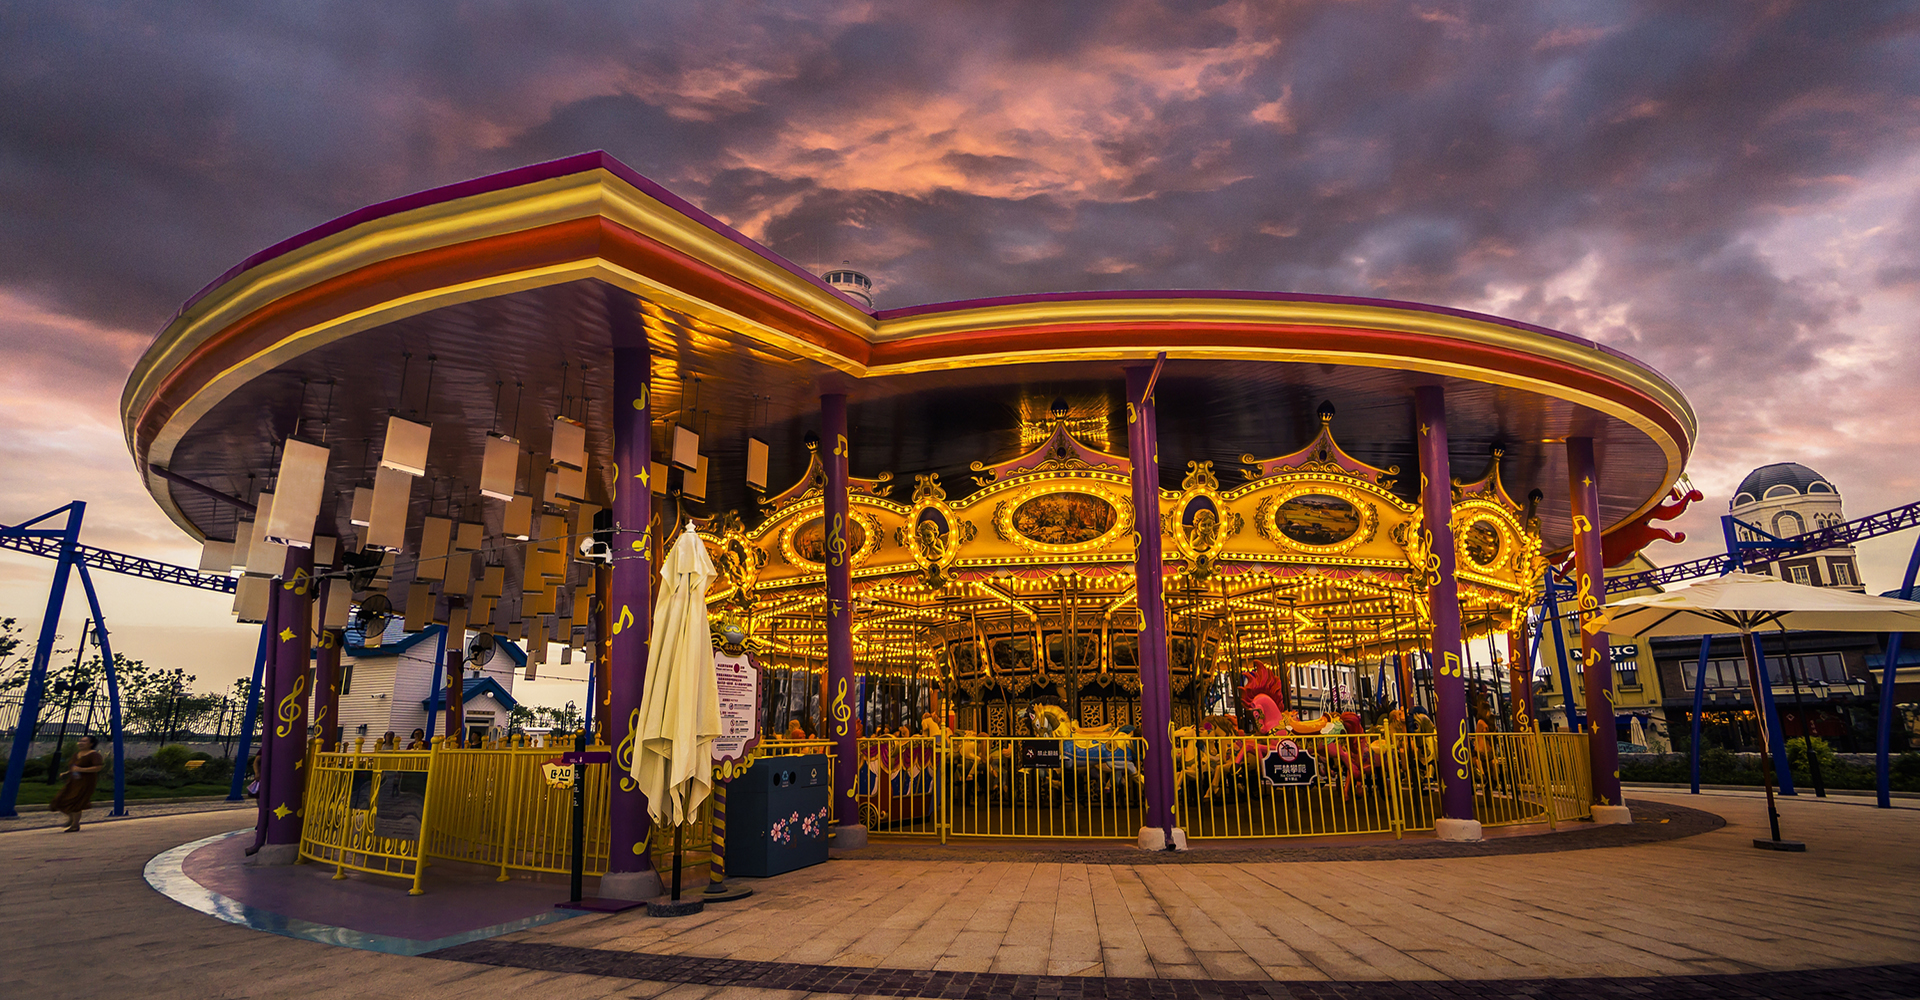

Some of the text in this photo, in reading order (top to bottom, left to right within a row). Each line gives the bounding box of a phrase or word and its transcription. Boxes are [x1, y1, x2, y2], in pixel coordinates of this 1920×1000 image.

[1573, 646, 1635, 658] MSIC
[1273, 764, 1307, 774] 严禁攀爬
